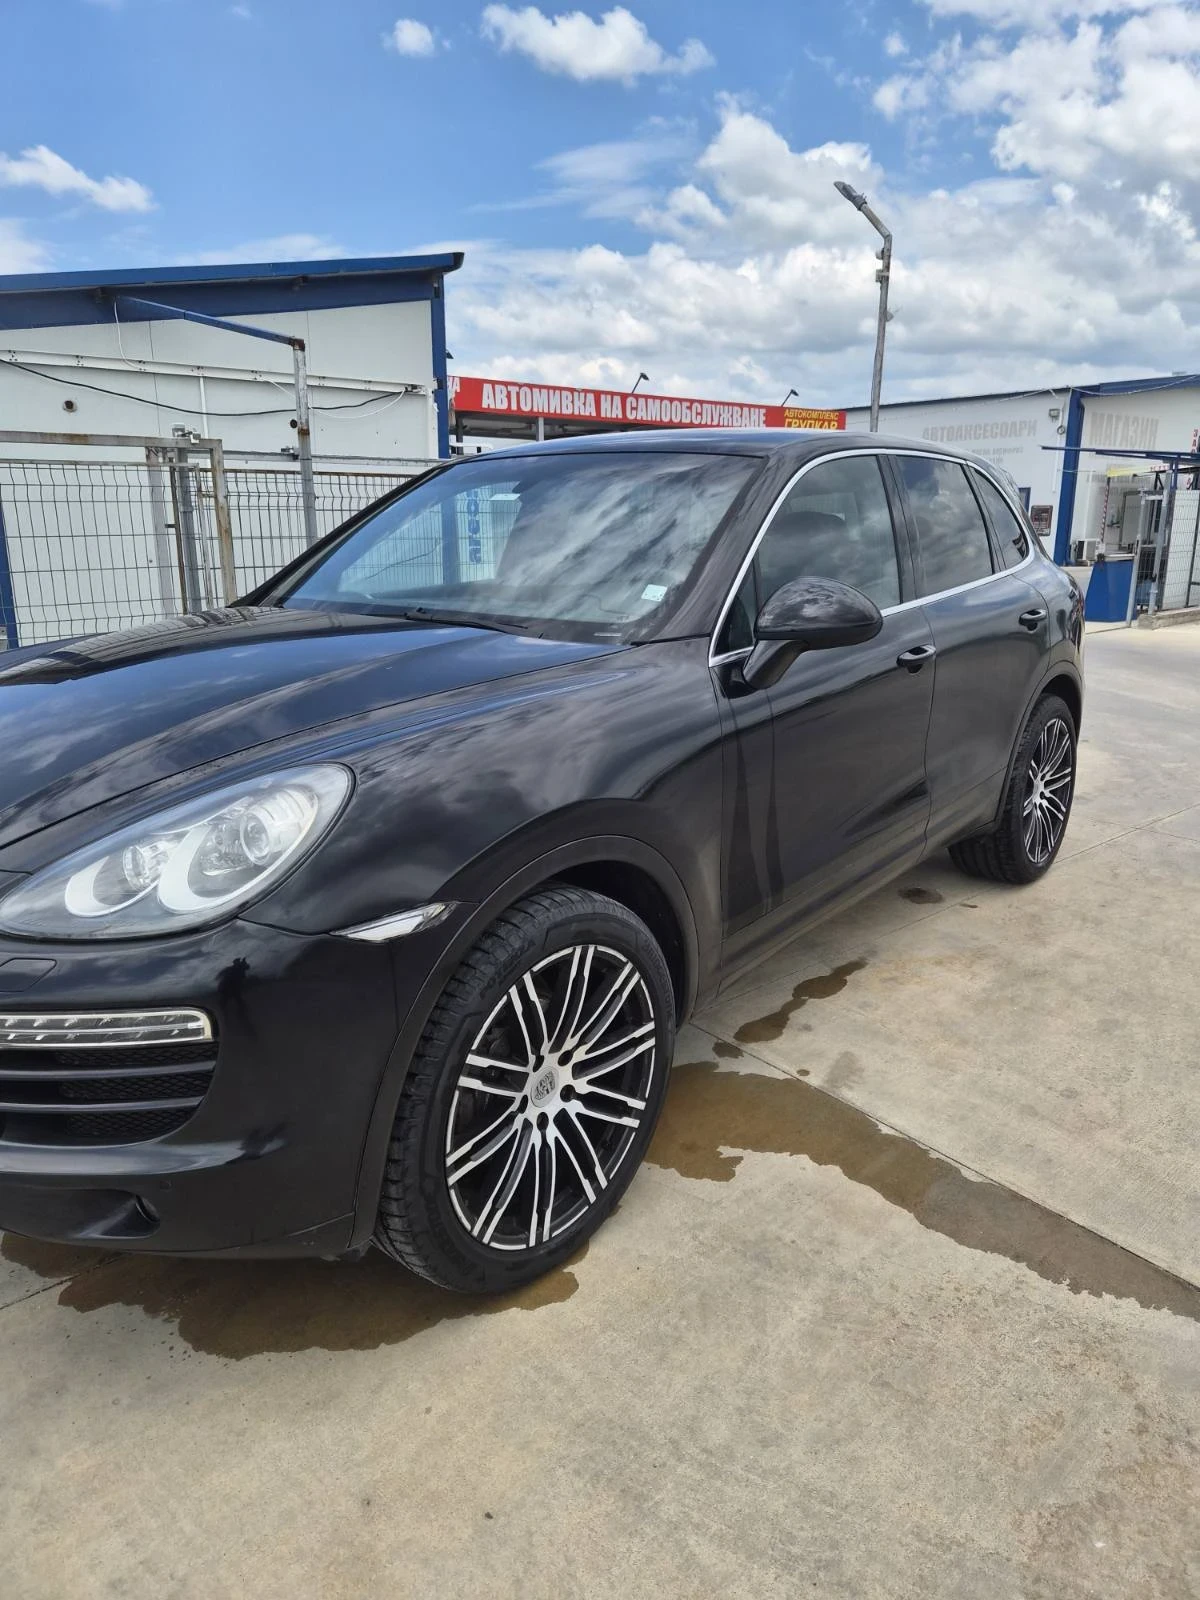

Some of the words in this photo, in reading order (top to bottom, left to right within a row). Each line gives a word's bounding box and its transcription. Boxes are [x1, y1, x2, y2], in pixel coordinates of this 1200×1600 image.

[481, 382, 597, 417] АВТОМИВКА
[600, 393, 623, 419] НА
[625, 396, 767, 428] САМООБСЛУЖВАНЕ
[784, 408, 840, 420] АВТОКОМПЛЕКС
[1089, 411, 1160, 450] МАГАЗИН
